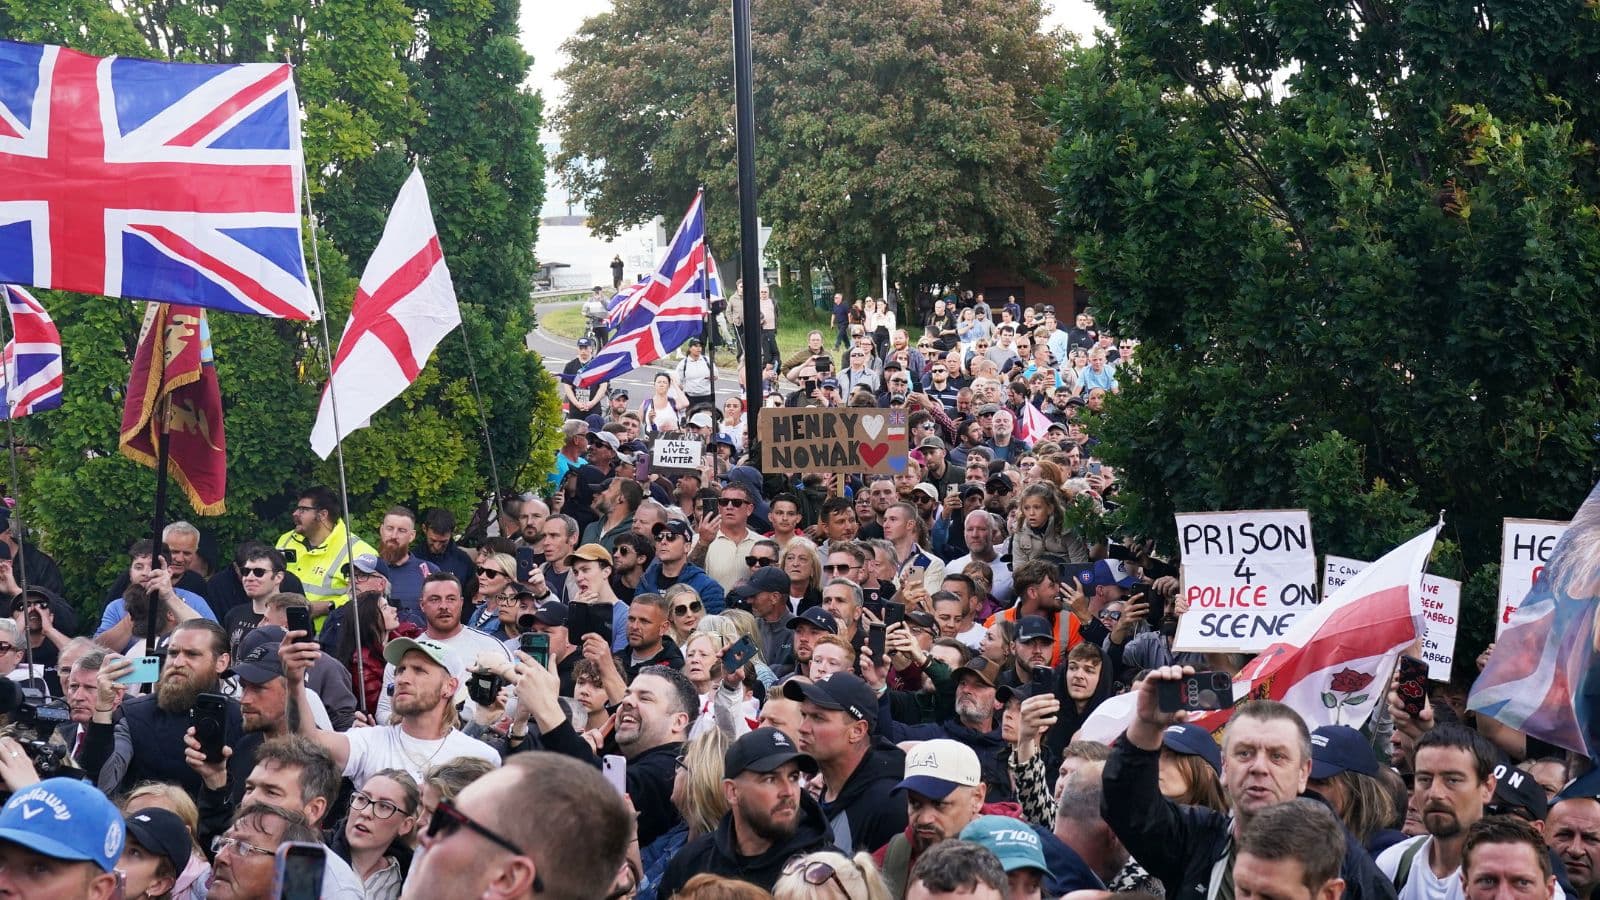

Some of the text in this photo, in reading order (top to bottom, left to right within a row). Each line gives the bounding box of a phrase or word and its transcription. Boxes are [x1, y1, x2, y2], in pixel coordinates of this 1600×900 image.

[772, 413, 858, 443] HENRY
[660, 455, 694, 464] MATTER
[662, 447, 690, 455] LIVES
[772, 440, 861, 469] NOWAK
[1183, 522, 1307, 555] PRISON
[1513, 533, 1557, 563] HE
[1233, 556, 1257, 585] 4
[1327, 563, 1361, 576] I CAN
[1187, 583, 1318, 608] POLICE ON
[1199, 613, 1296, 638] SCENE
[1422, 609, 1455, 625] TABBED
[1422, 650, 1452, 665] ABBED
[908, 752, 939, 769] LA
